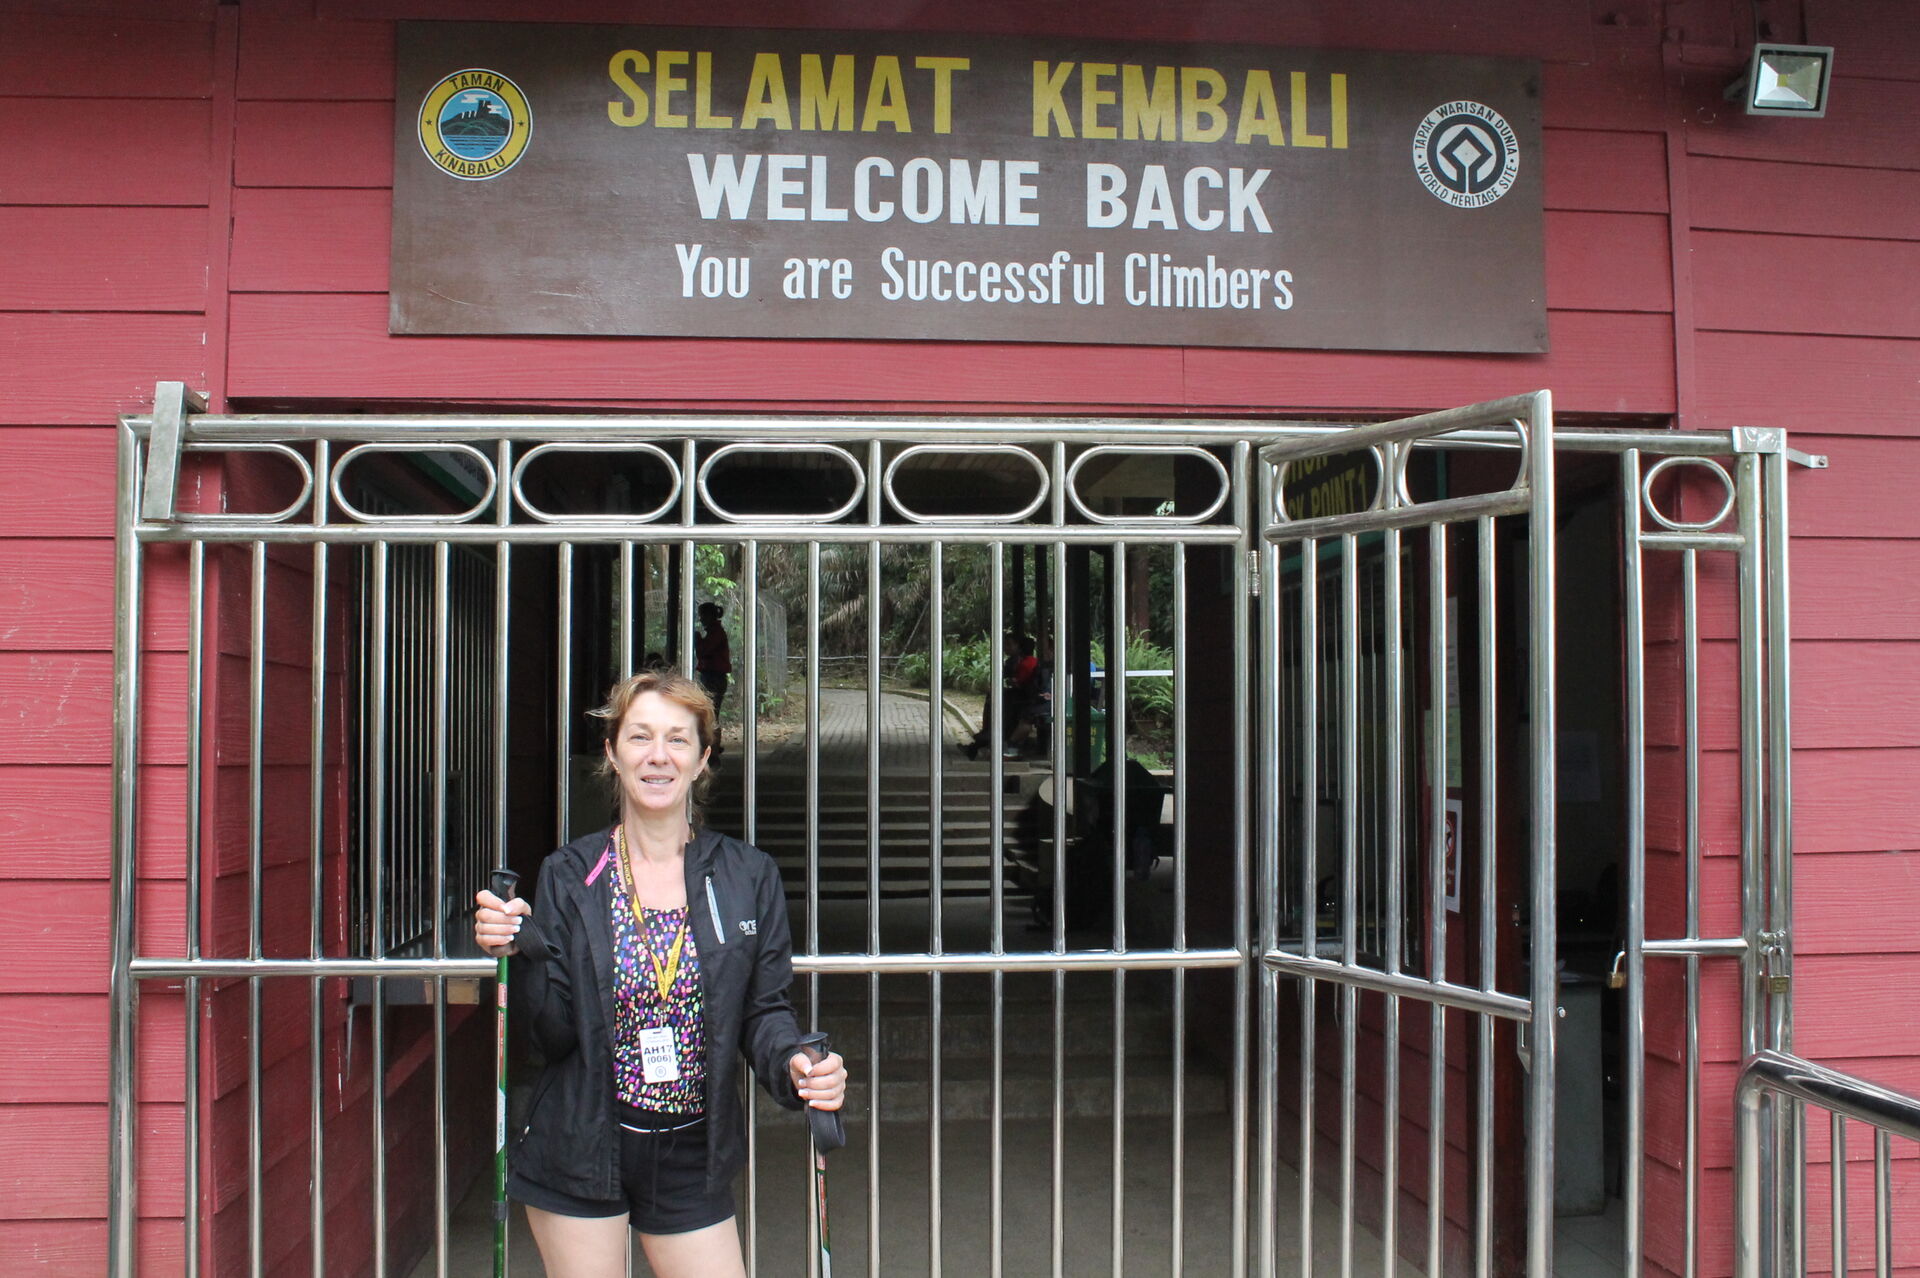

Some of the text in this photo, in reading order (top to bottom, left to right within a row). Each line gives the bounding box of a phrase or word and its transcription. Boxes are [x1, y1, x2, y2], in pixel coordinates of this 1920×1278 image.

[448, 73, 505, 91] TAMAN
[608, 50, 1349, 149] SELAMAT KEMBALI
[1415, 102, 1517, 155] TAPAK WARISAN DUNIA
[435, 149, 506, 175] KINABALU
[1417, 162, 1516, 206] WORLD HERITAGE SITE
[687, 154, 1273, 234] WELCOME BACK
[675, 244, 1294, 310] You are Successful Climbers
[643, 1044, 673, 1055] AH17
